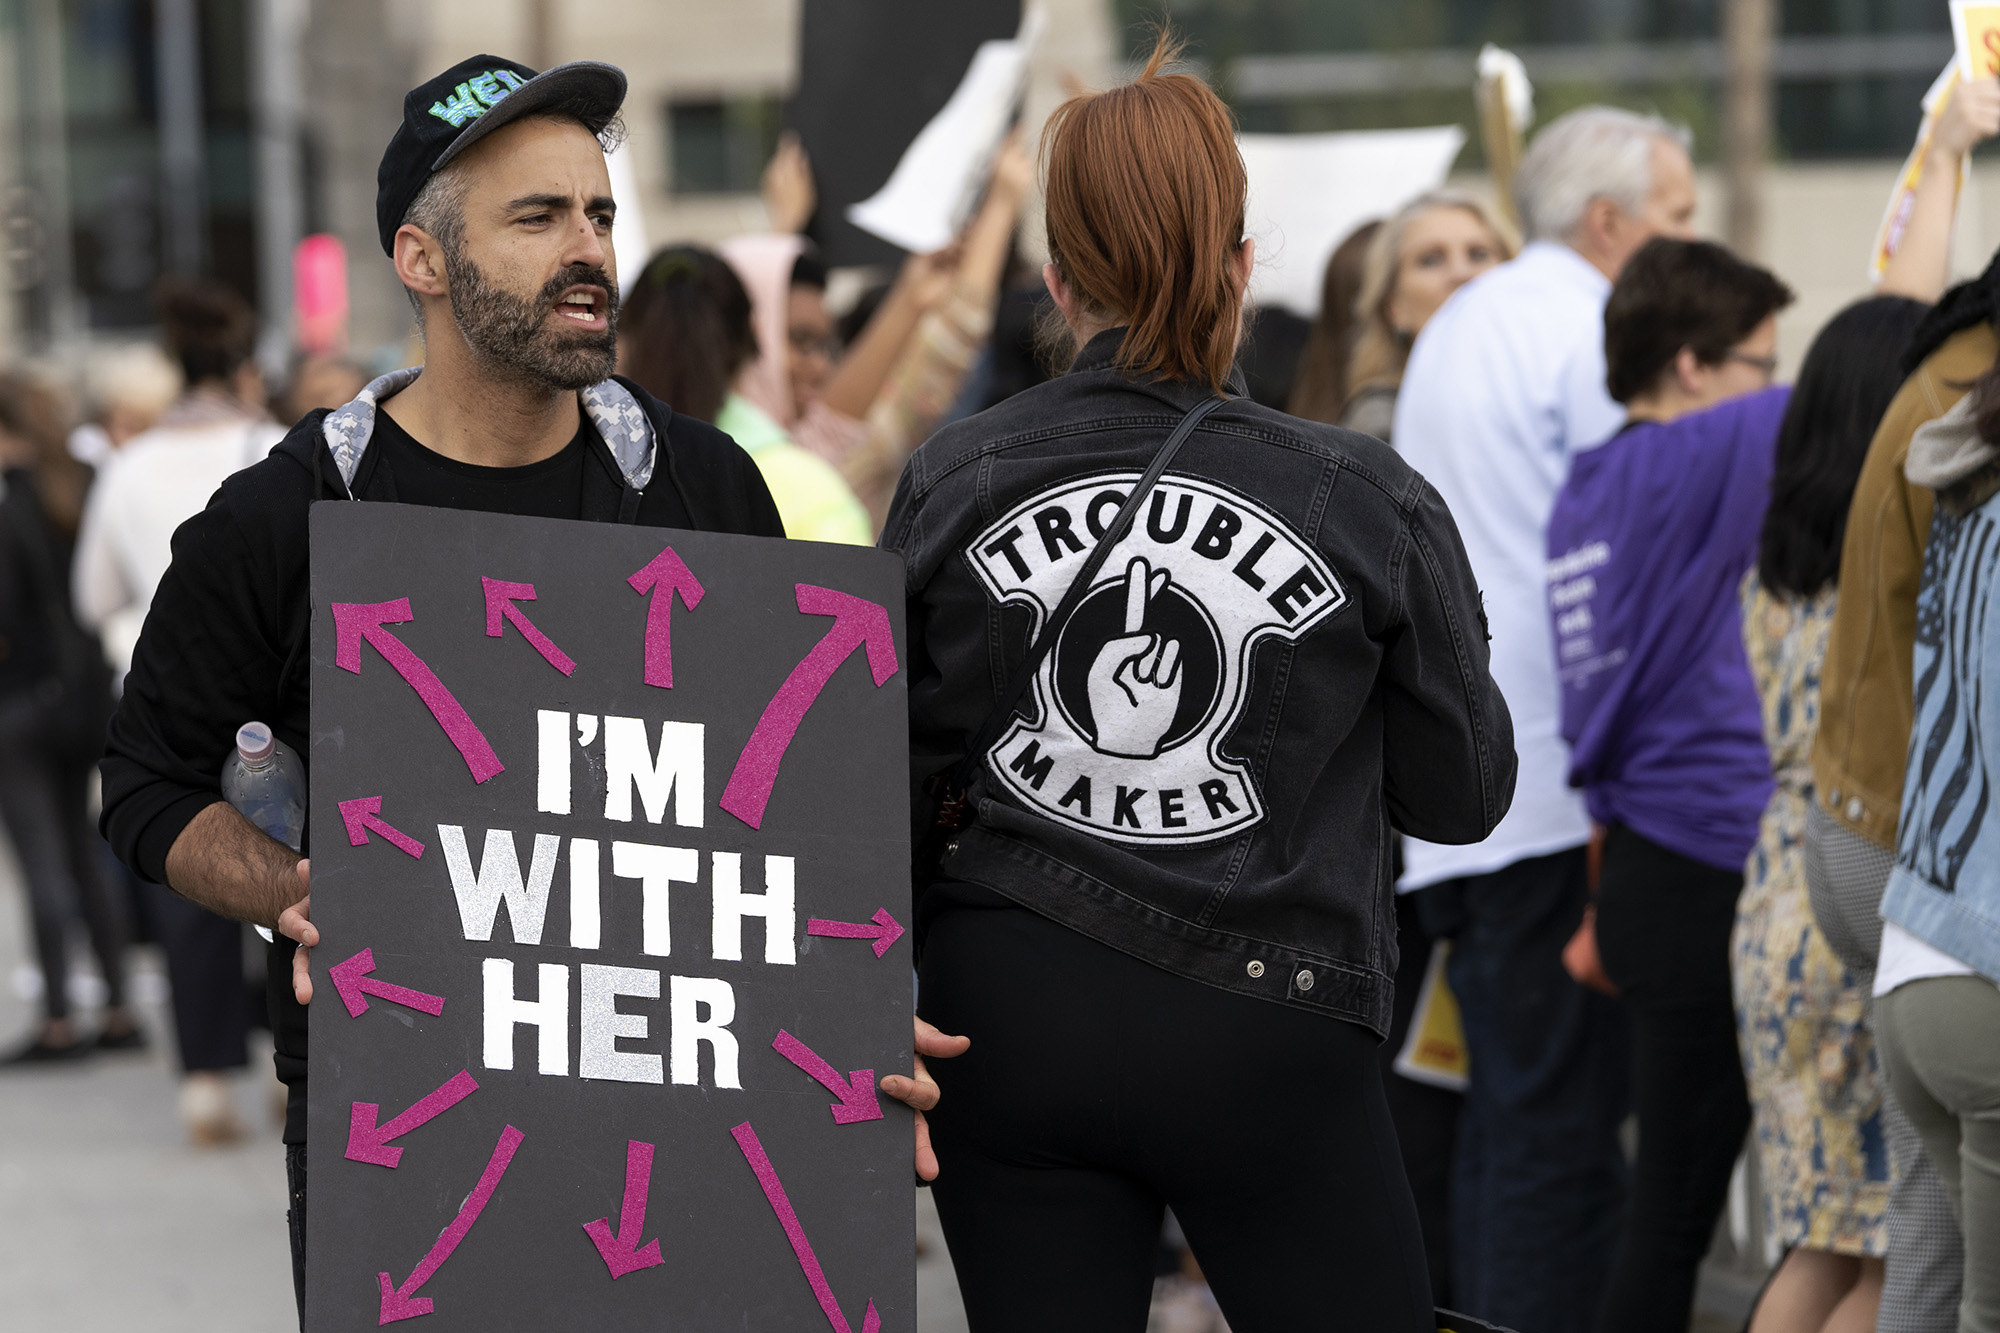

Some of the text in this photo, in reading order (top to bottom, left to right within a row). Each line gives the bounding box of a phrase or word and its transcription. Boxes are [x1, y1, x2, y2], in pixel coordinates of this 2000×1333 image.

[984, 489, 1327, 624] TROUBLE
[537, 709, 705, 828] I'M
[1009, 738, 1240, 829] MAKER
[437, 823, 797, 966] WITH
[482, 957, 743, 1090] HER
